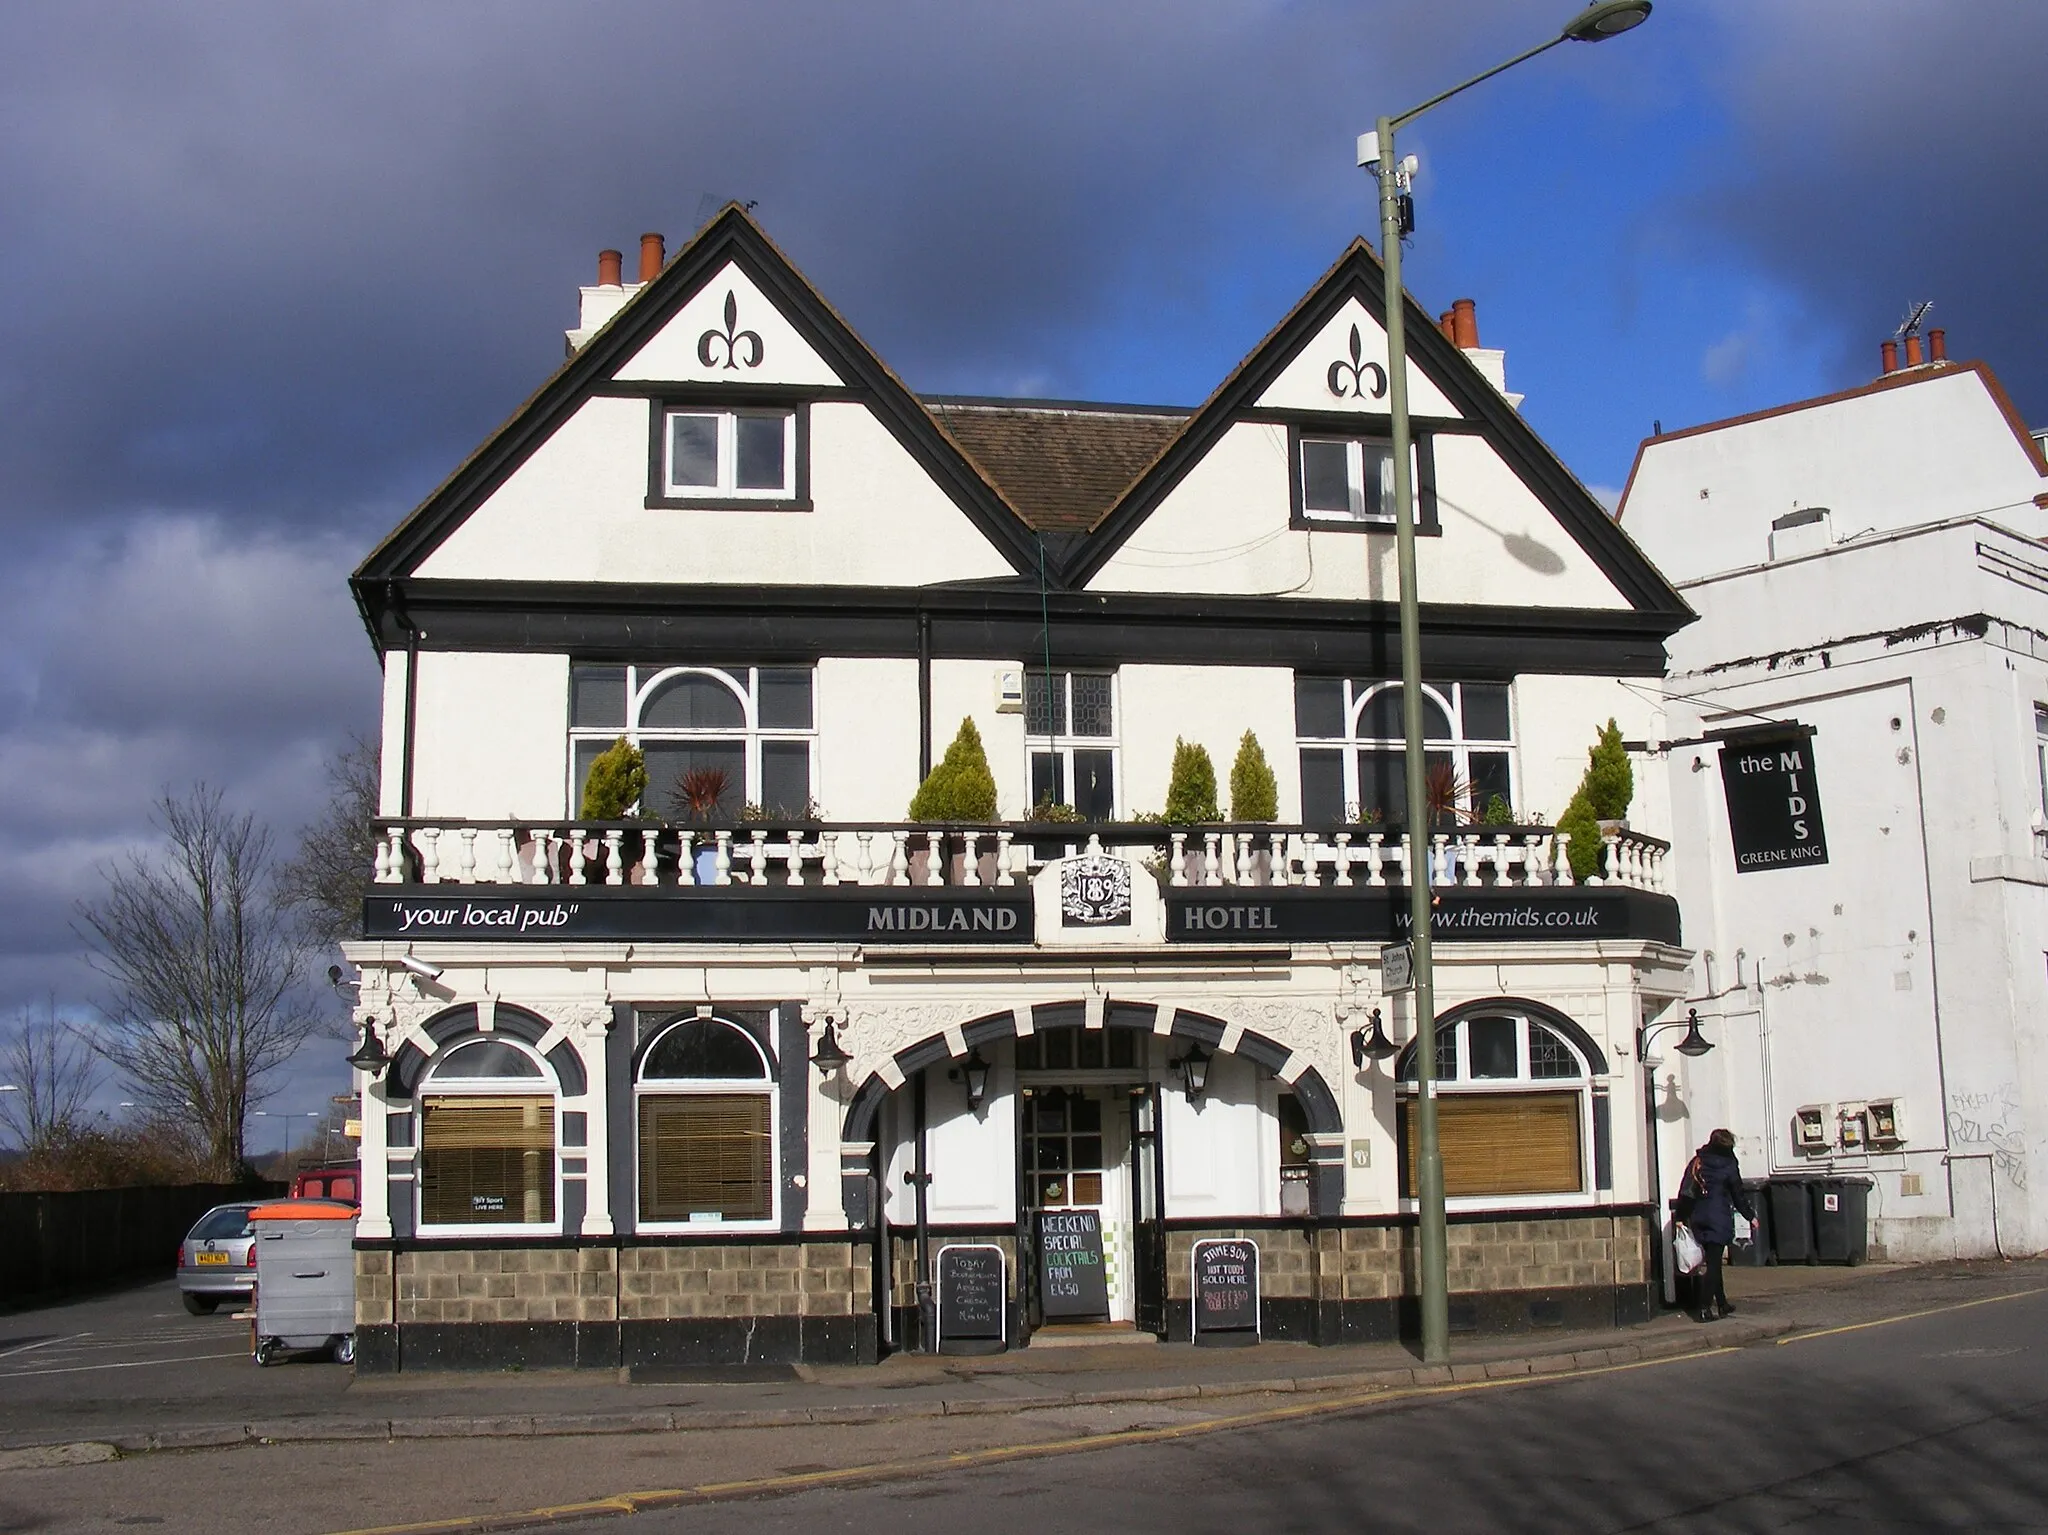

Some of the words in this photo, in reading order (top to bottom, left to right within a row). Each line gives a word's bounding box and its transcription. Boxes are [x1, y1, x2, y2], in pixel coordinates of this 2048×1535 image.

[1739, 755, 1774, 774] the
[1740, 849, 1788, 866] GREENE
[1790, 845, 1822, 859] KING
[393, 902, 459, 932] "your
[462, 903, 520, 926] local
[519, 903, 579, 933] pub"
[866, 906, 1018, 933] MIDLAND
[1184, 905, 1279, 931] HOTEL
[1395, 905, 1600, 928] ww.themids.co.uk
[1041, 1215, 1096, 1233] WEEKEND
[1044, 1234, 1085, 1251] SPECIAL
[1046, 1250, 1099, 1267] COCKTAILS
[1202, 1244, 1249, 1263] JAMESON
[1048, 1267, 1073, 1281] FROM
[1207, 1264, 1221, 1275] HOT
[1202, 1275, 1225, 1285] SOLD
[1226, 1275, 1248, 1285] HERE
